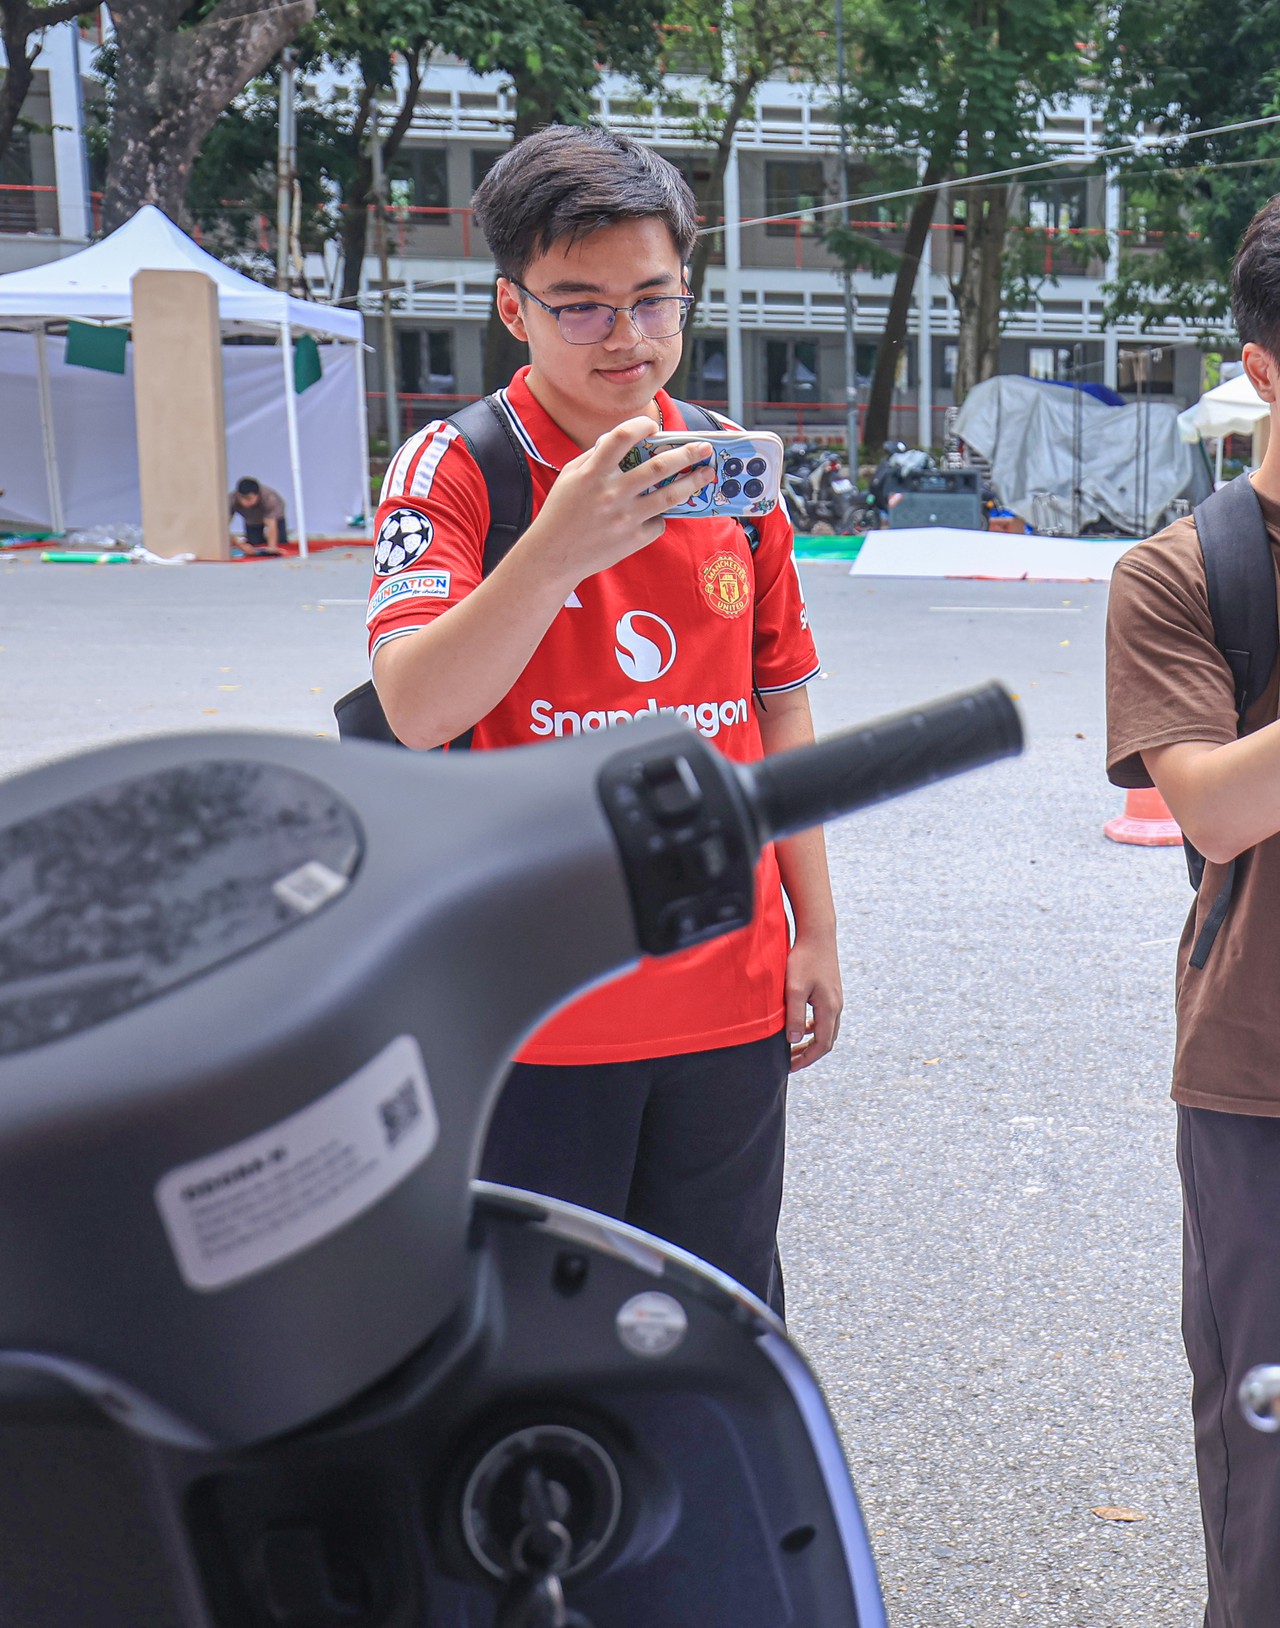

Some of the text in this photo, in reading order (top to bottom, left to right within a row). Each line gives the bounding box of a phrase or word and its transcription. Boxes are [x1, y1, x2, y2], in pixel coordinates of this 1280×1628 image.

[708, 561, 746, 580] MANCHESTER
[369, 579, 447, 611] OUNDATION
[717, 601, 744, 611] UNITED
